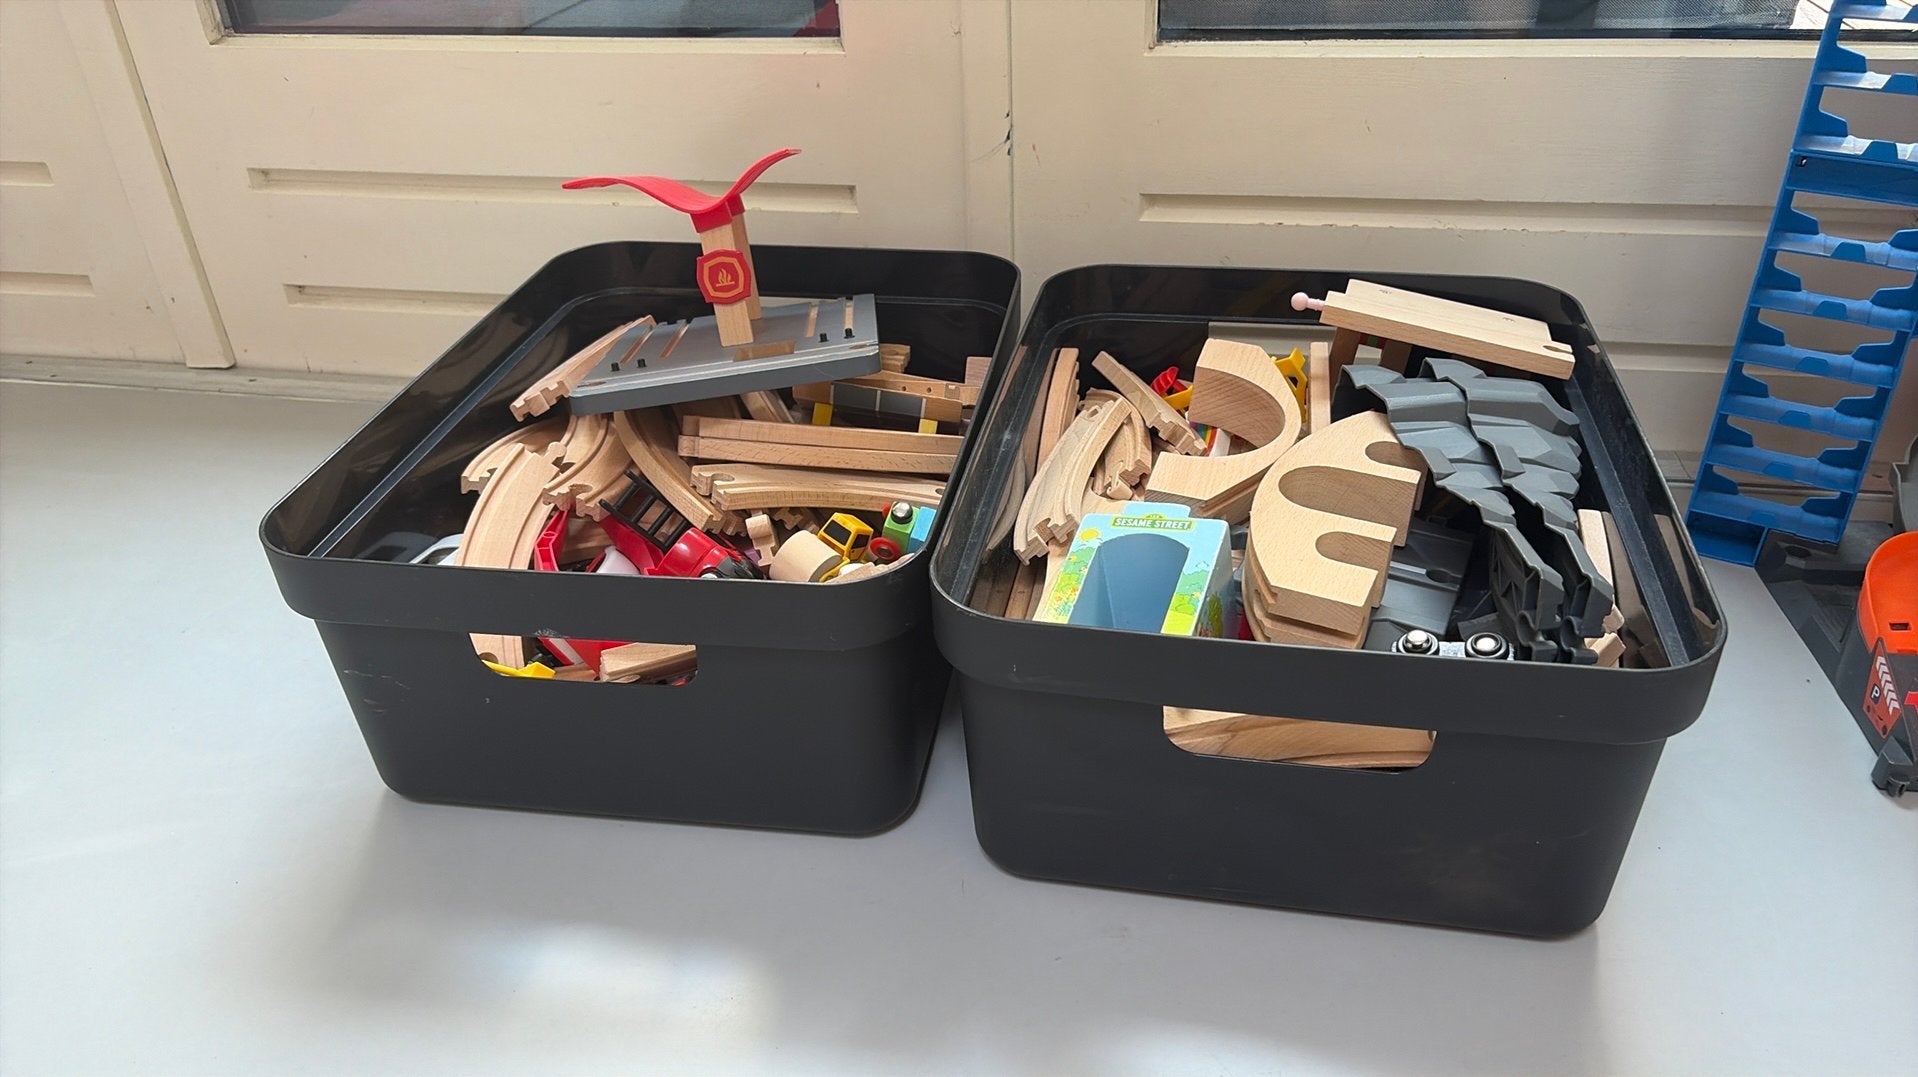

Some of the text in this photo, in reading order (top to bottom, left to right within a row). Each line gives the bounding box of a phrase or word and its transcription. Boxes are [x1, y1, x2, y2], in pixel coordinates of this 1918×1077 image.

[1115, 518, 1190, 529] SESAME STREET
[1871, 685, 1880, 698] P
